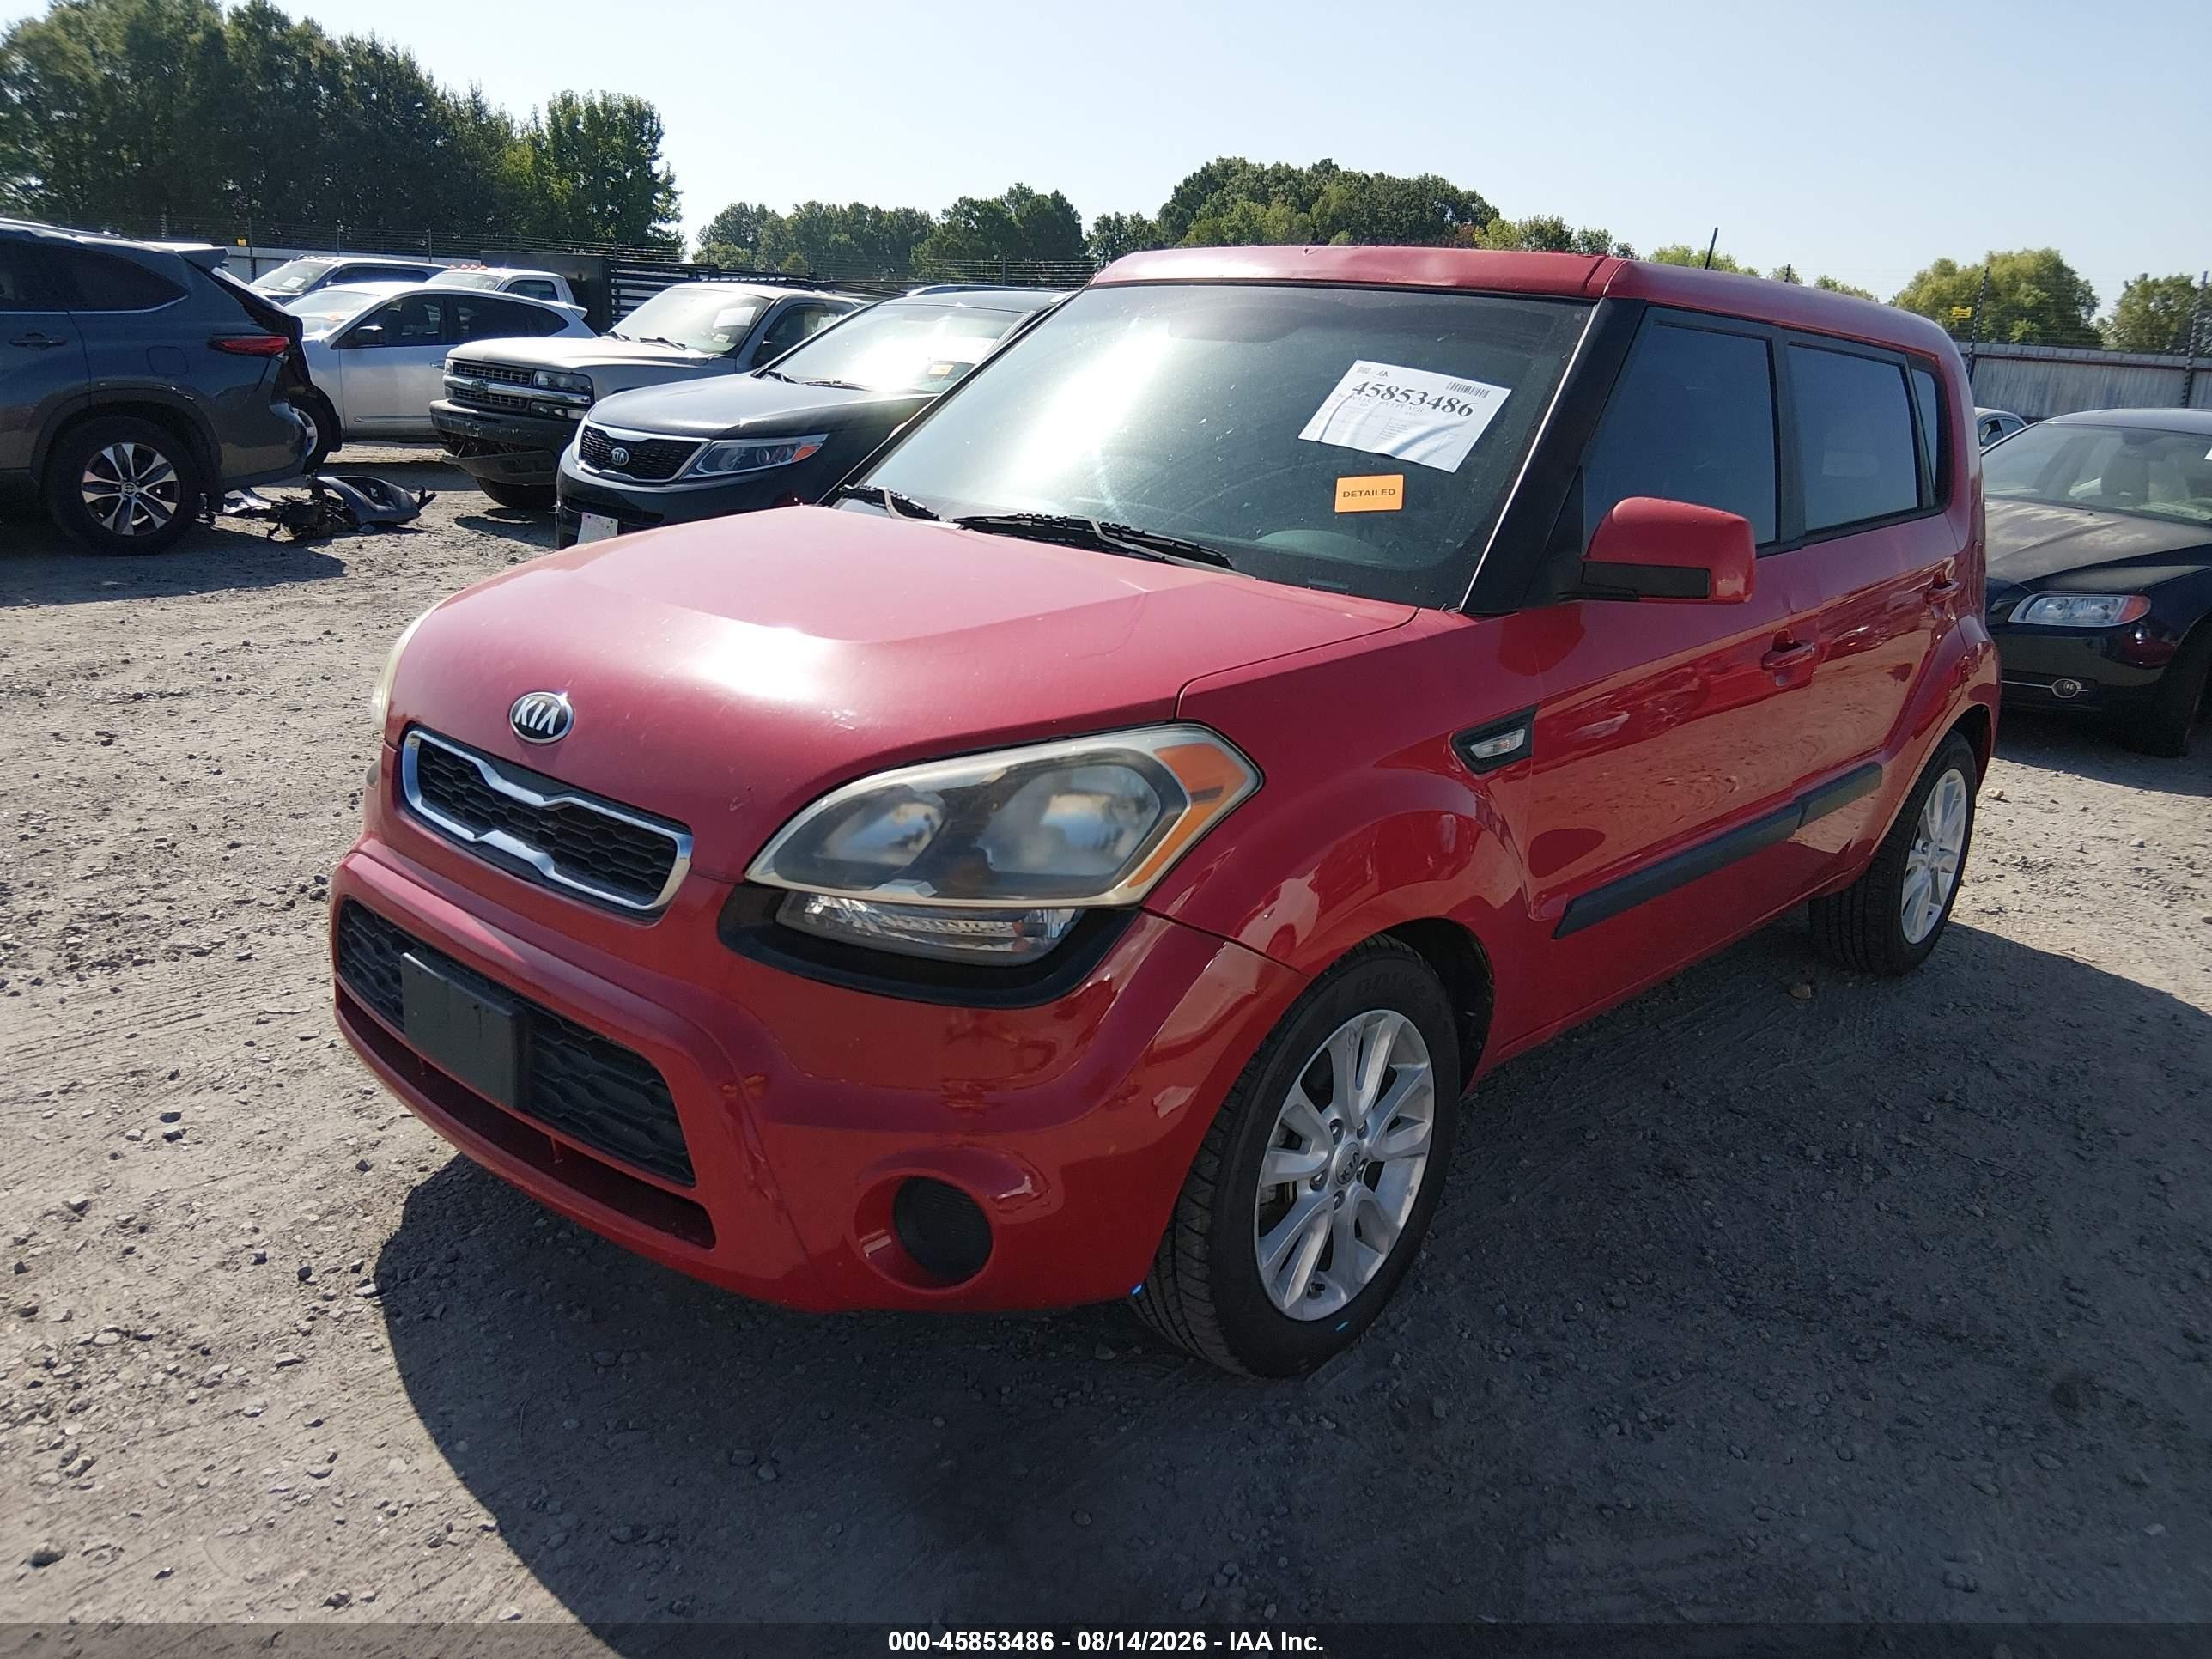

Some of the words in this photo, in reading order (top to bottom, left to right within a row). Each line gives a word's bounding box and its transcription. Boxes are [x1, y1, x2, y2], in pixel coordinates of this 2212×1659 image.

[1352, 381, 1478, 417] 45853486
[1342, 489, 1396, 498] DETAILED
[514, 697, 560, 735] KIA
